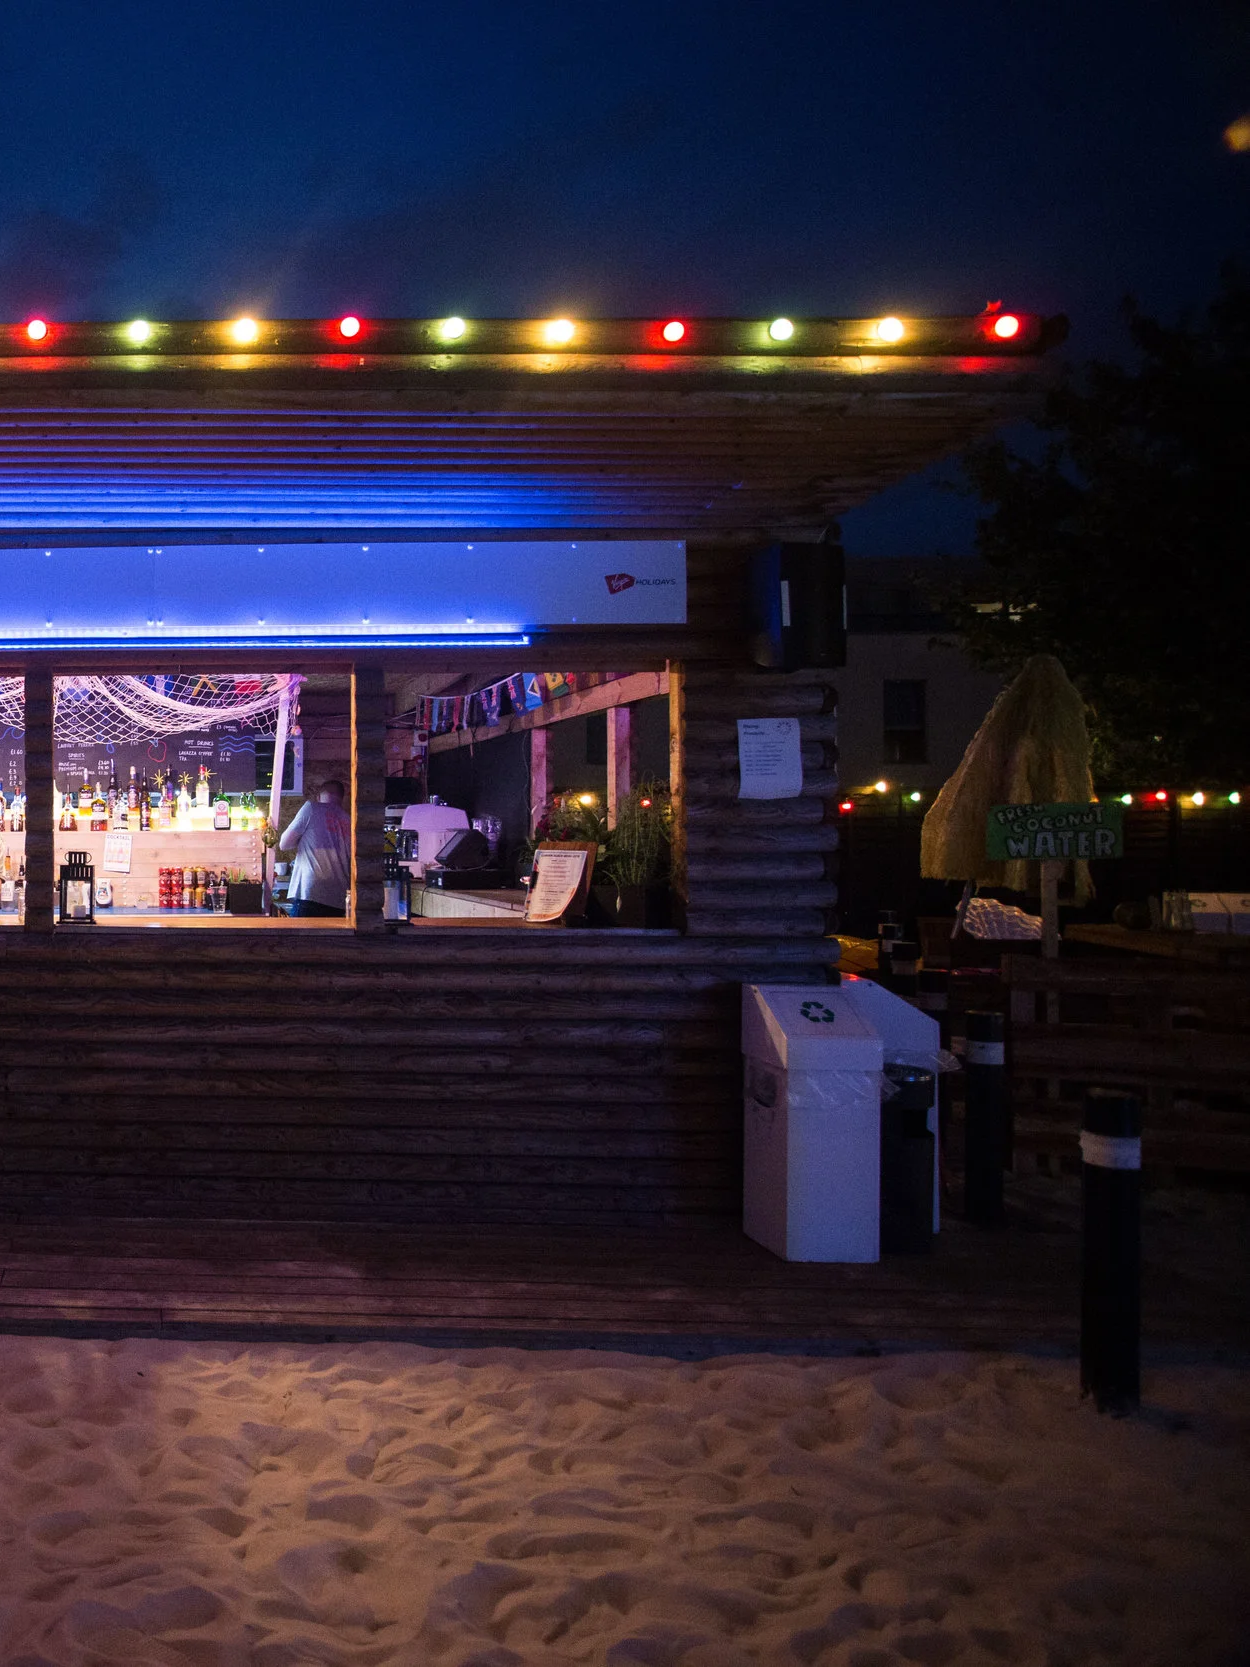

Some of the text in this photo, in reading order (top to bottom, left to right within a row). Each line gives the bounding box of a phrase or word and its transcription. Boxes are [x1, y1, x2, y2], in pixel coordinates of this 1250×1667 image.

[635, 578, 676, 586] HOLIDAYS
[997, 804, 1044, 824] FRESH
[1012, 806, 1104, 833] COCONUT
[1006, 829, 1116, 857] WATER
